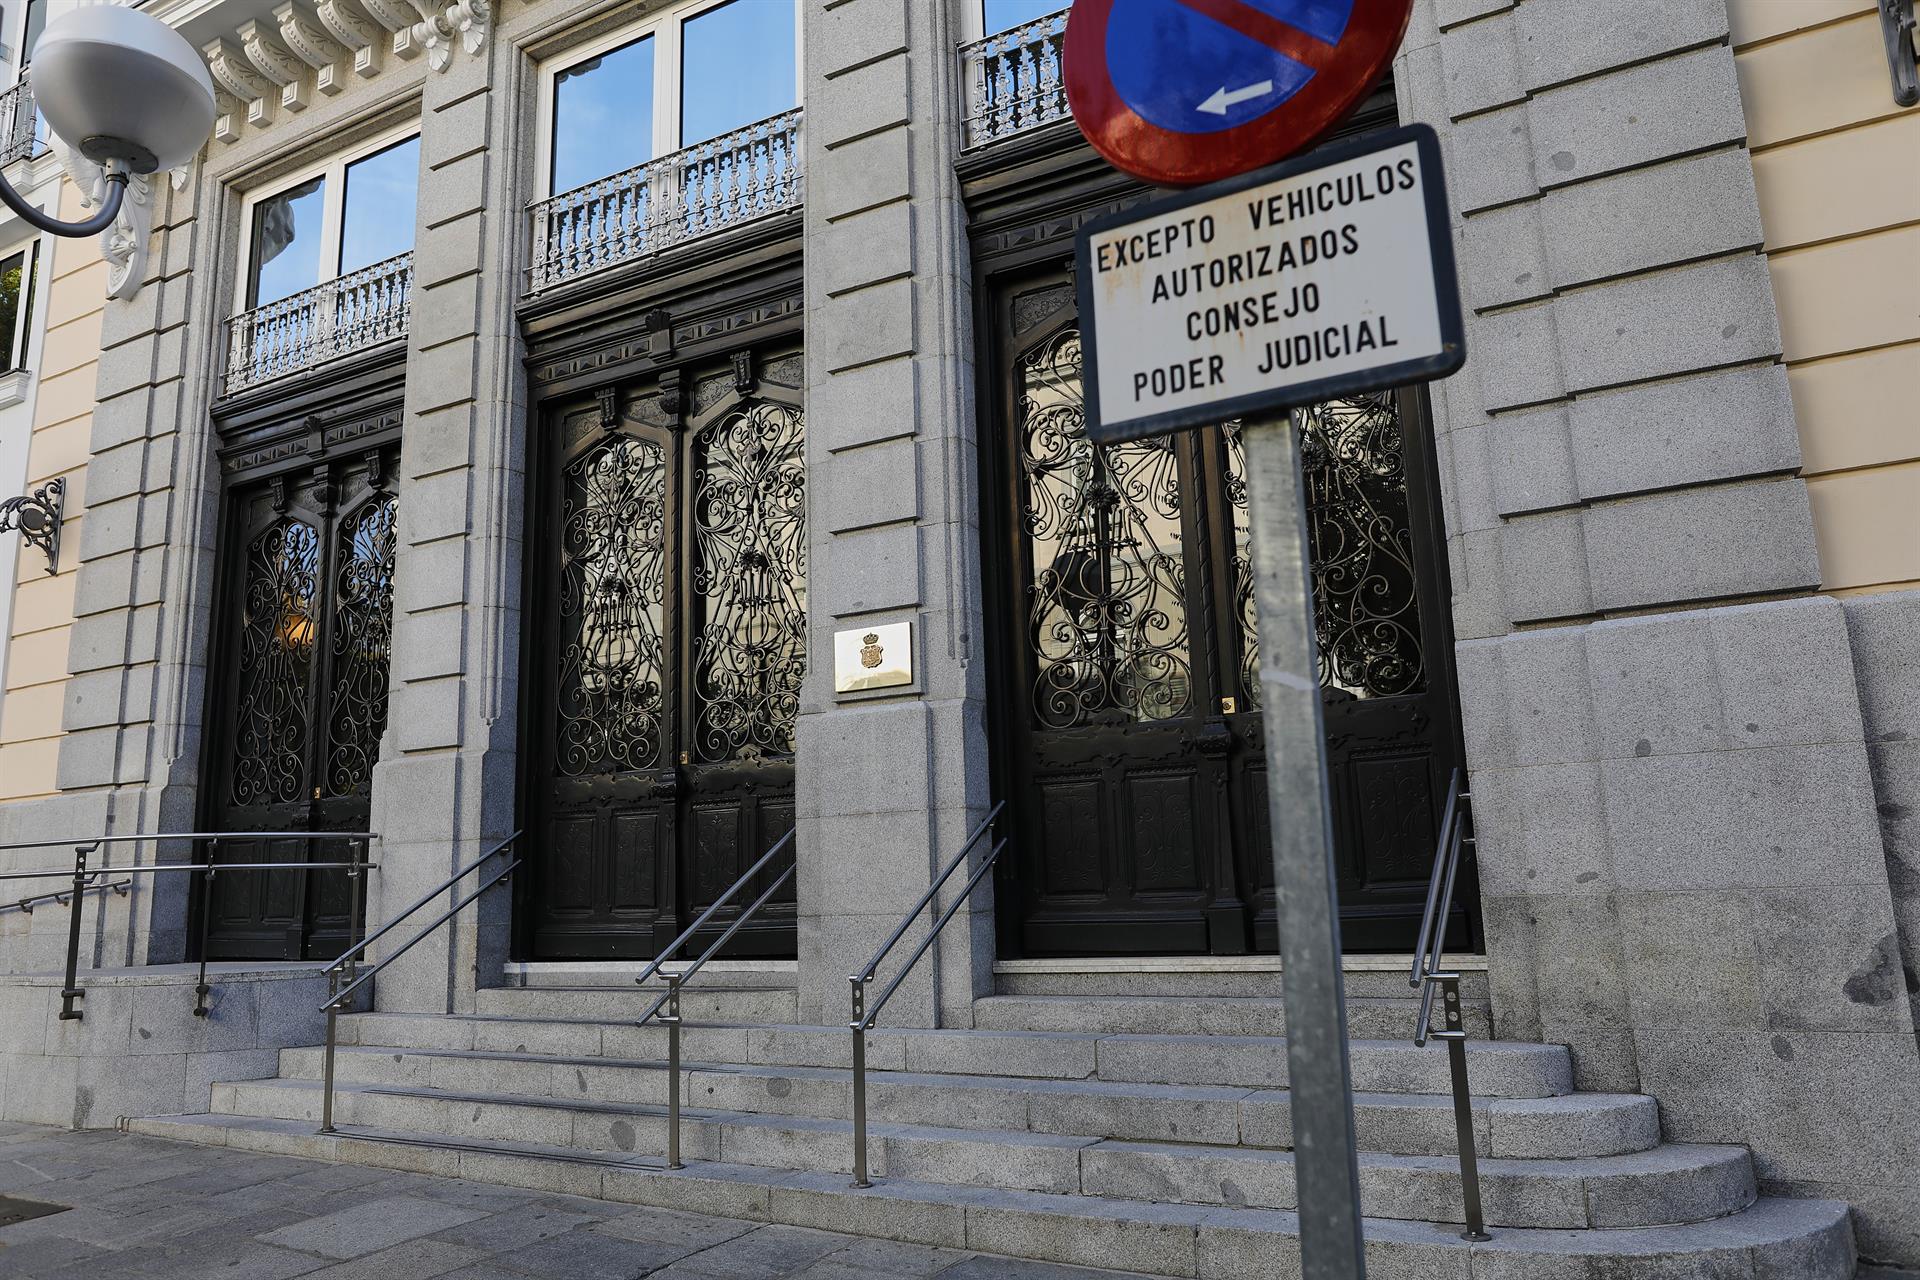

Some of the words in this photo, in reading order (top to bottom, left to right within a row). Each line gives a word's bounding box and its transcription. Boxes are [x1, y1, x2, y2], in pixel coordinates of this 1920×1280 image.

[1096, 214, 1215, 274] EXCEPTO
[1247, 157, 1416, 231] VEHICULOS
[1151, 222, 1360, 305] AUTORIZADOS
[1186, 282, 1320, 342] CONSEJO
[1133, 354, 1225, 403] PODER
[1257, 315, 1399, 375] JUDICIAL
